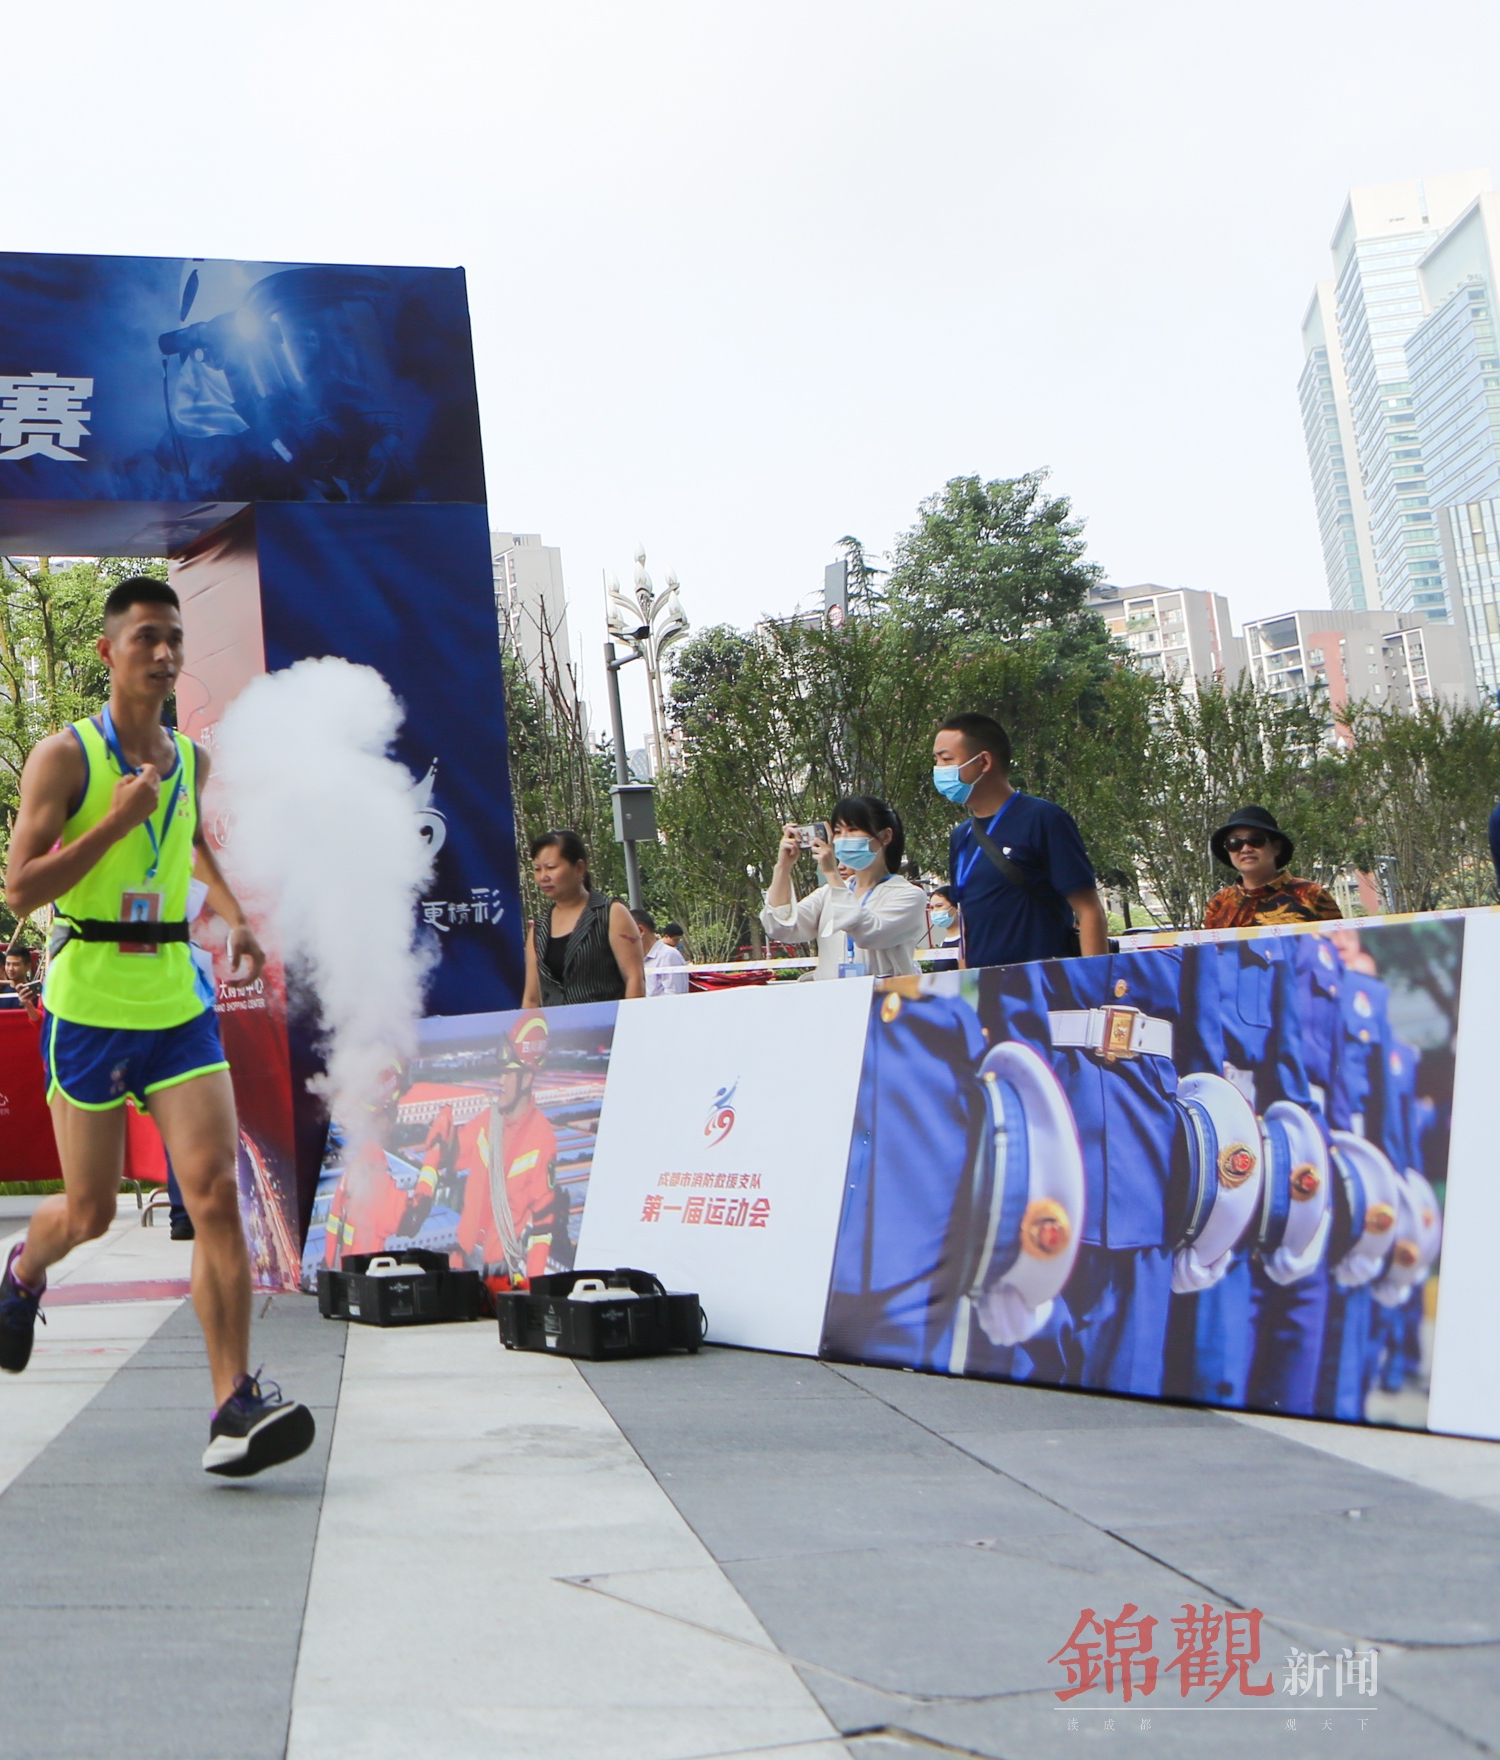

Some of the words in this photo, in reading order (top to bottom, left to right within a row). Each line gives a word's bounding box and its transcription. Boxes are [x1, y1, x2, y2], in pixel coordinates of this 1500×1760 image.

[657, 1171, 762, 1189] 成都市消防救援支队
[640, 1194, 771, 1228] 第一届运动会
